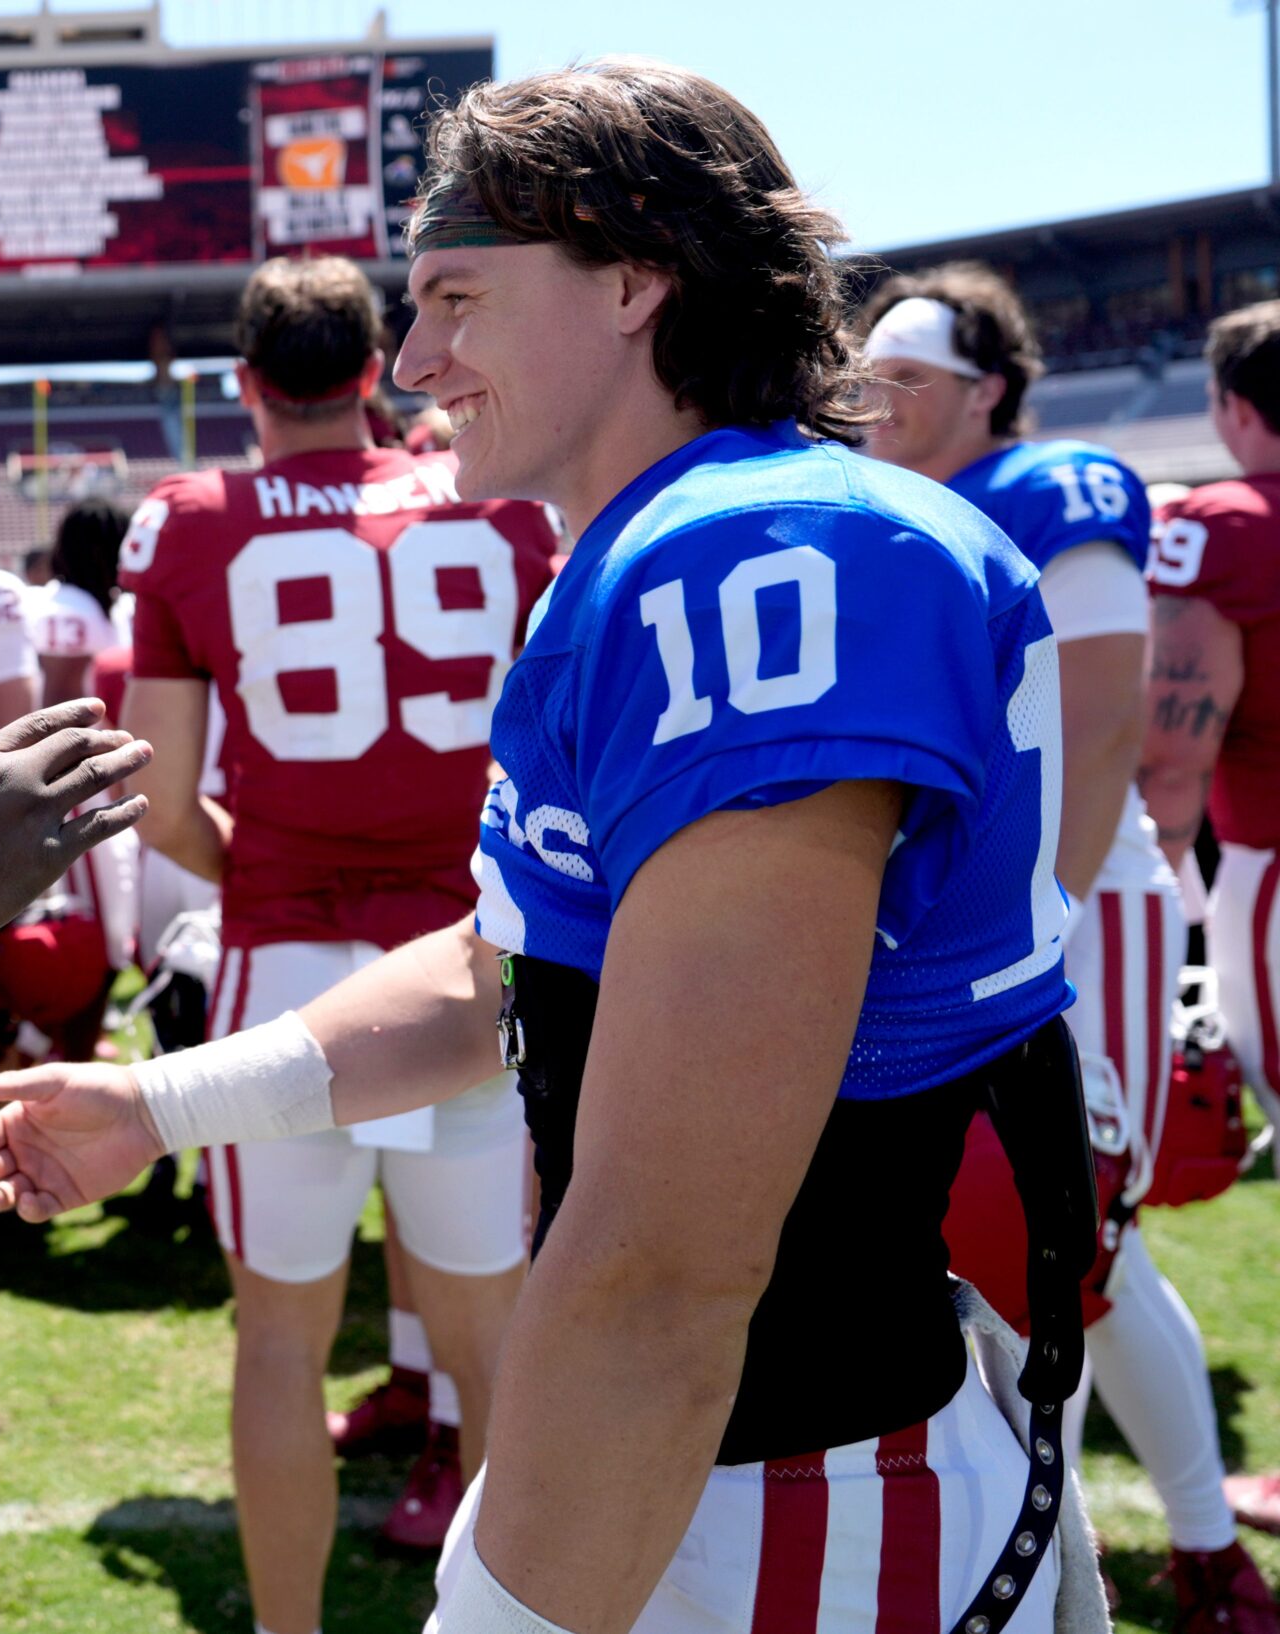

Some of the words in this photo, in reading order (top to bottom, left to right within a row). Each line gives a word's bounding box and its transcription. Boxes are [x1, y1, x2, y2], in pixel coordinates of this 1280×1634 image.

[1050, 461, 1130, 523] 16
[47, 616, 86, 648] 13
[227, 518, 519, 761] 89
[640, 545, 837, 745] 10
